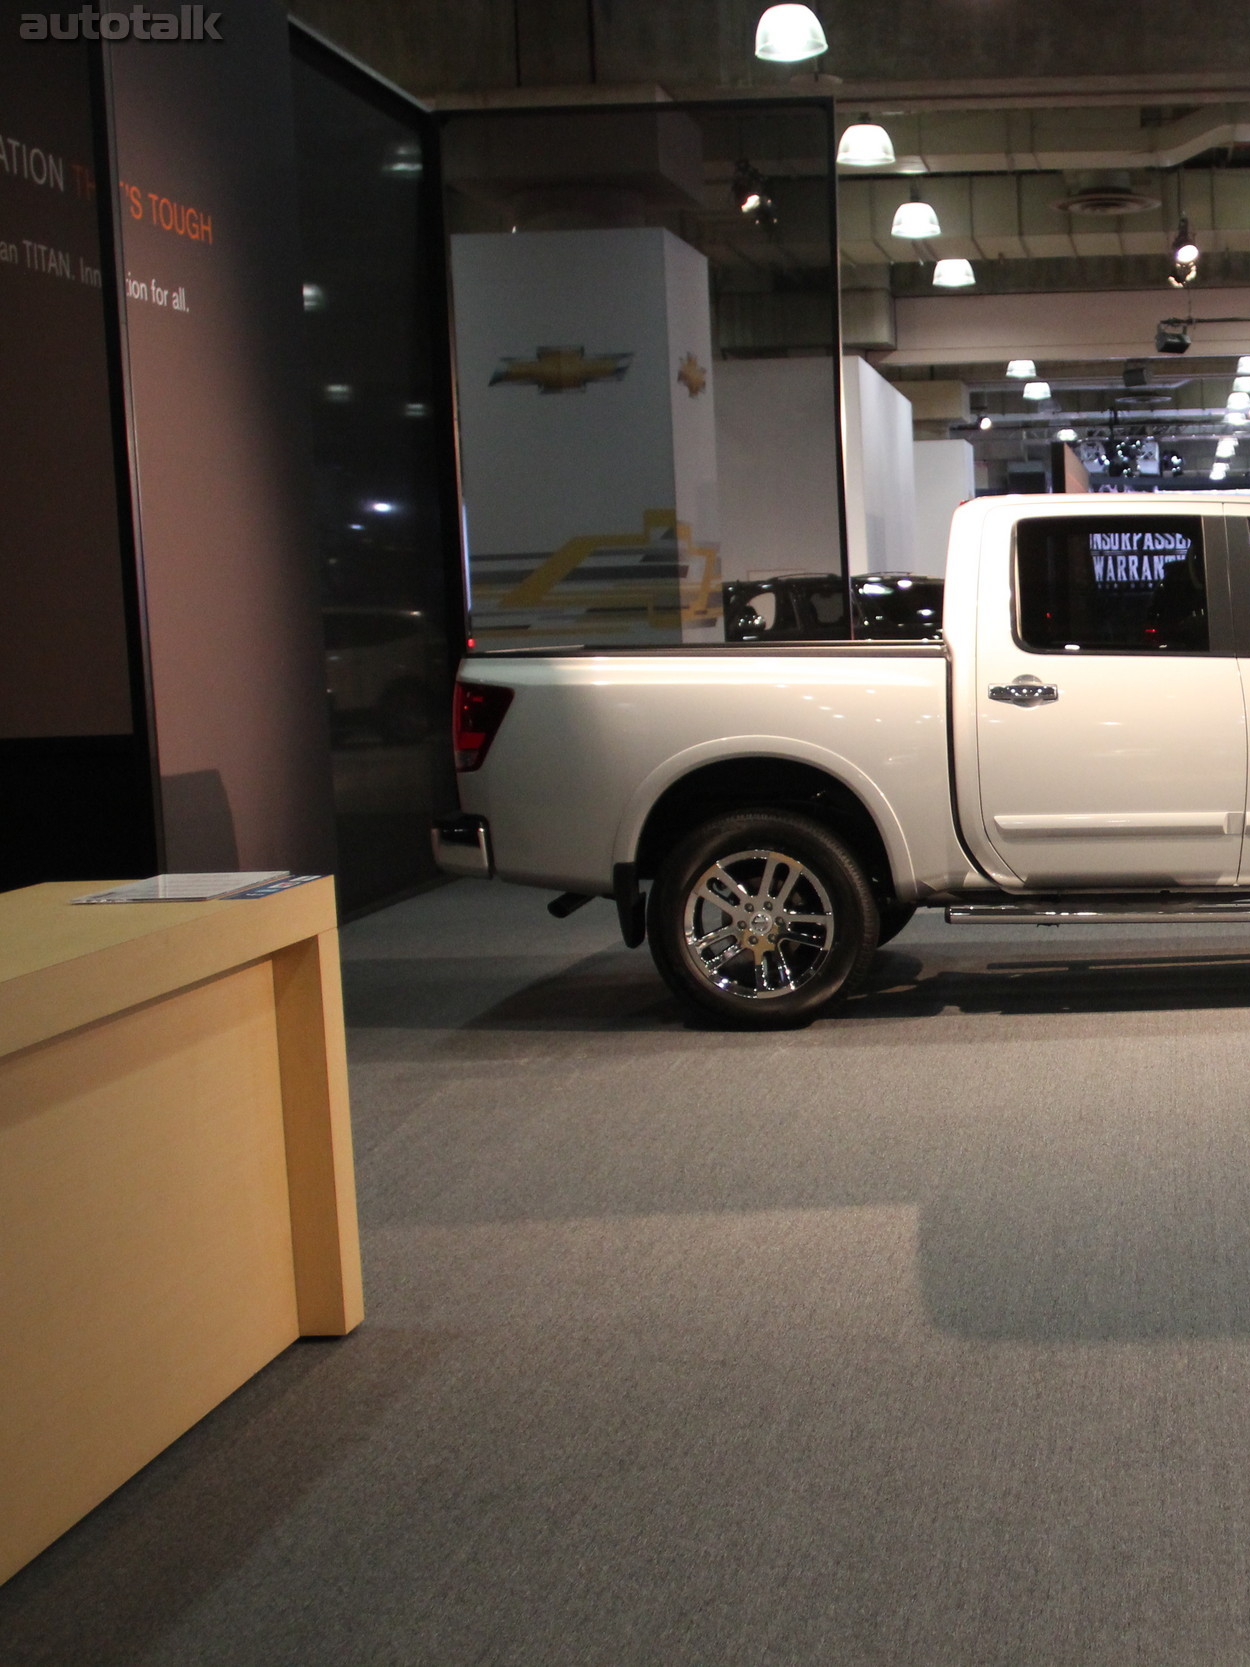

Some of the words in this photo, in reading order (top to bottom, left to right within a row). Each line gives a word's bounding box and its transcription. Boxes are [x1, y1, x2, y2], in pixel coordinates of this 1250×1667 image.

[148, 193, 213, 244] TOUGH
[23, 239, 76, 281] TITAN.
[151, 278, 169, 307] for
[172, 287, 190, 313] all.
[1092, 554, 1187, 582] WARRAN
